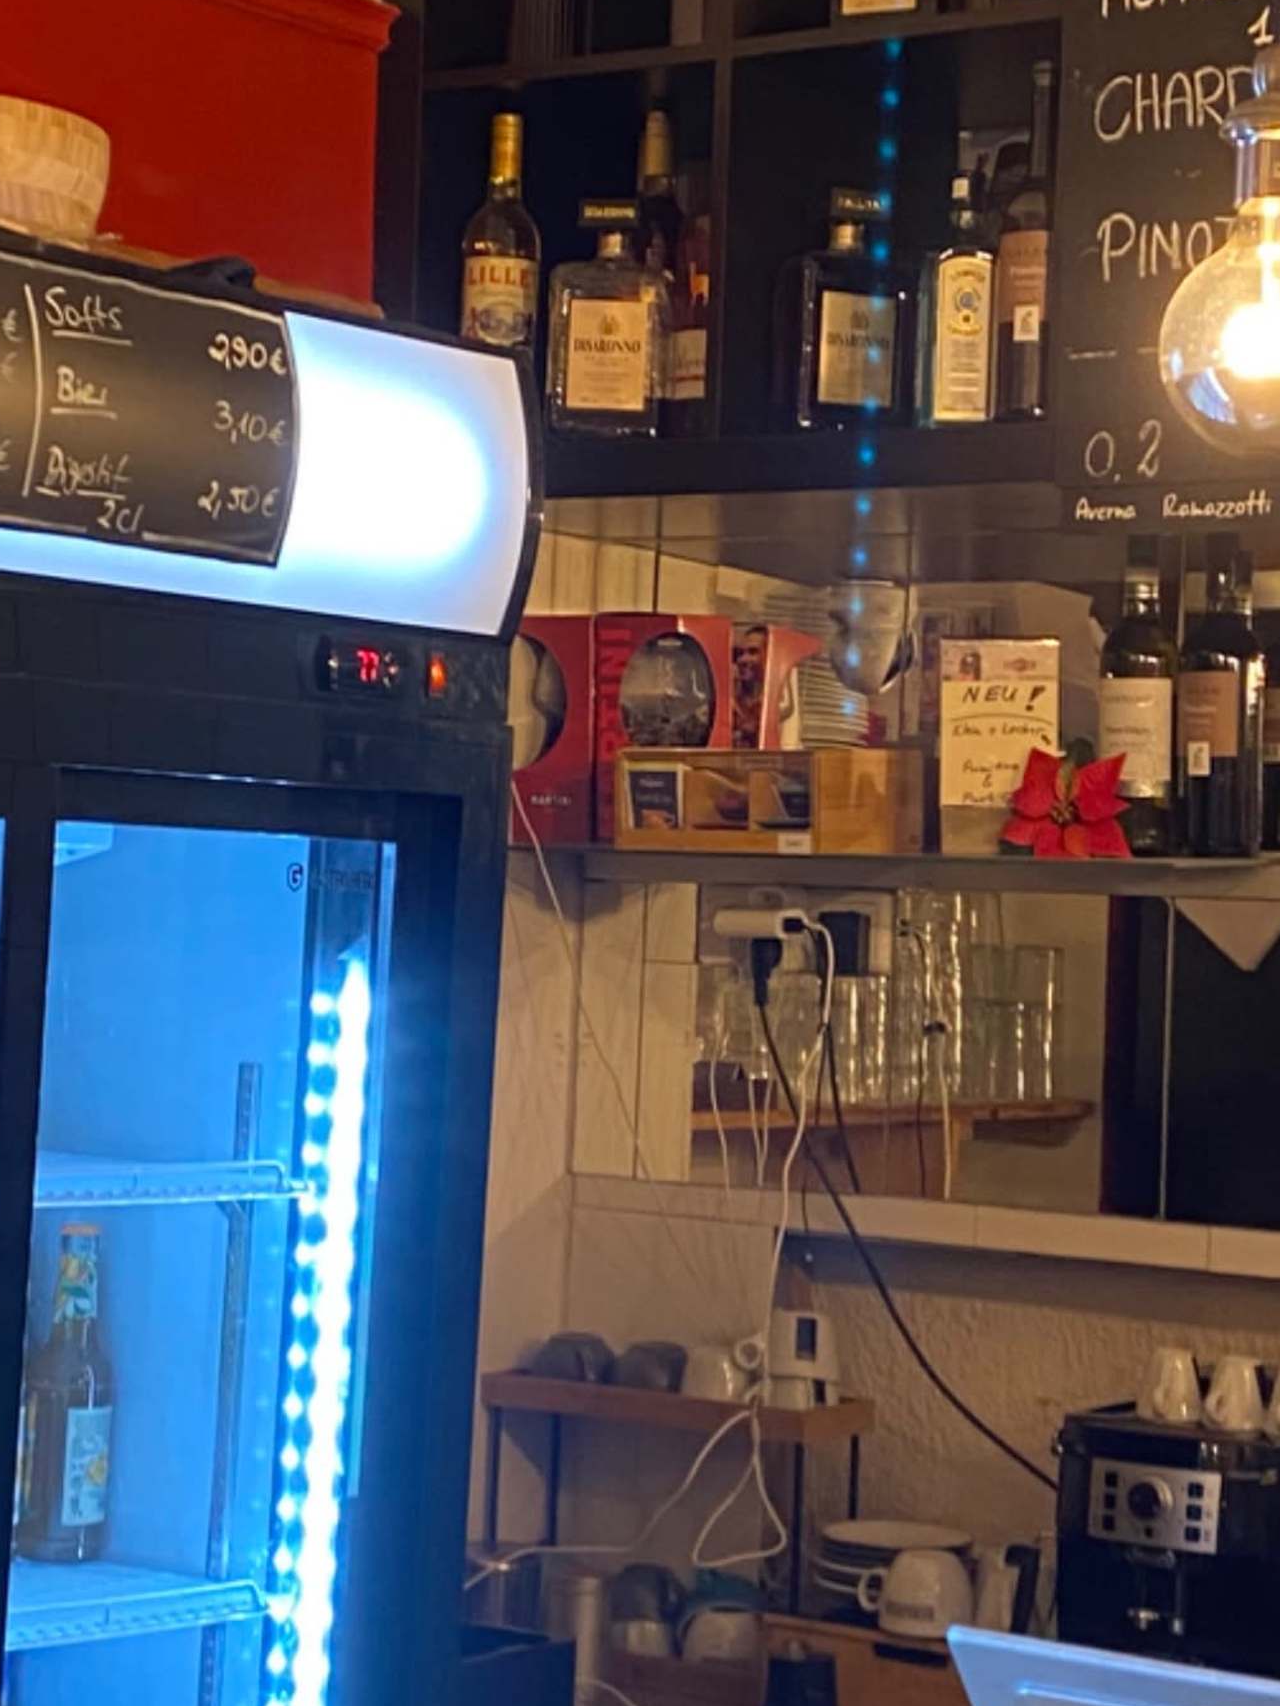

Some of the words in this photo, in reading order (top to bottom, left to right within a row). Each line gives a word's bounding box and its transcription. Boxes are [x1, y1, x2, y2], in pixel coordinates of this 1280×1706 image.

[45, 286, 123, 331] Softs
[57, 365, 107, 405] Bier
[1162, 489, 1273, 519] Ramazzotti
